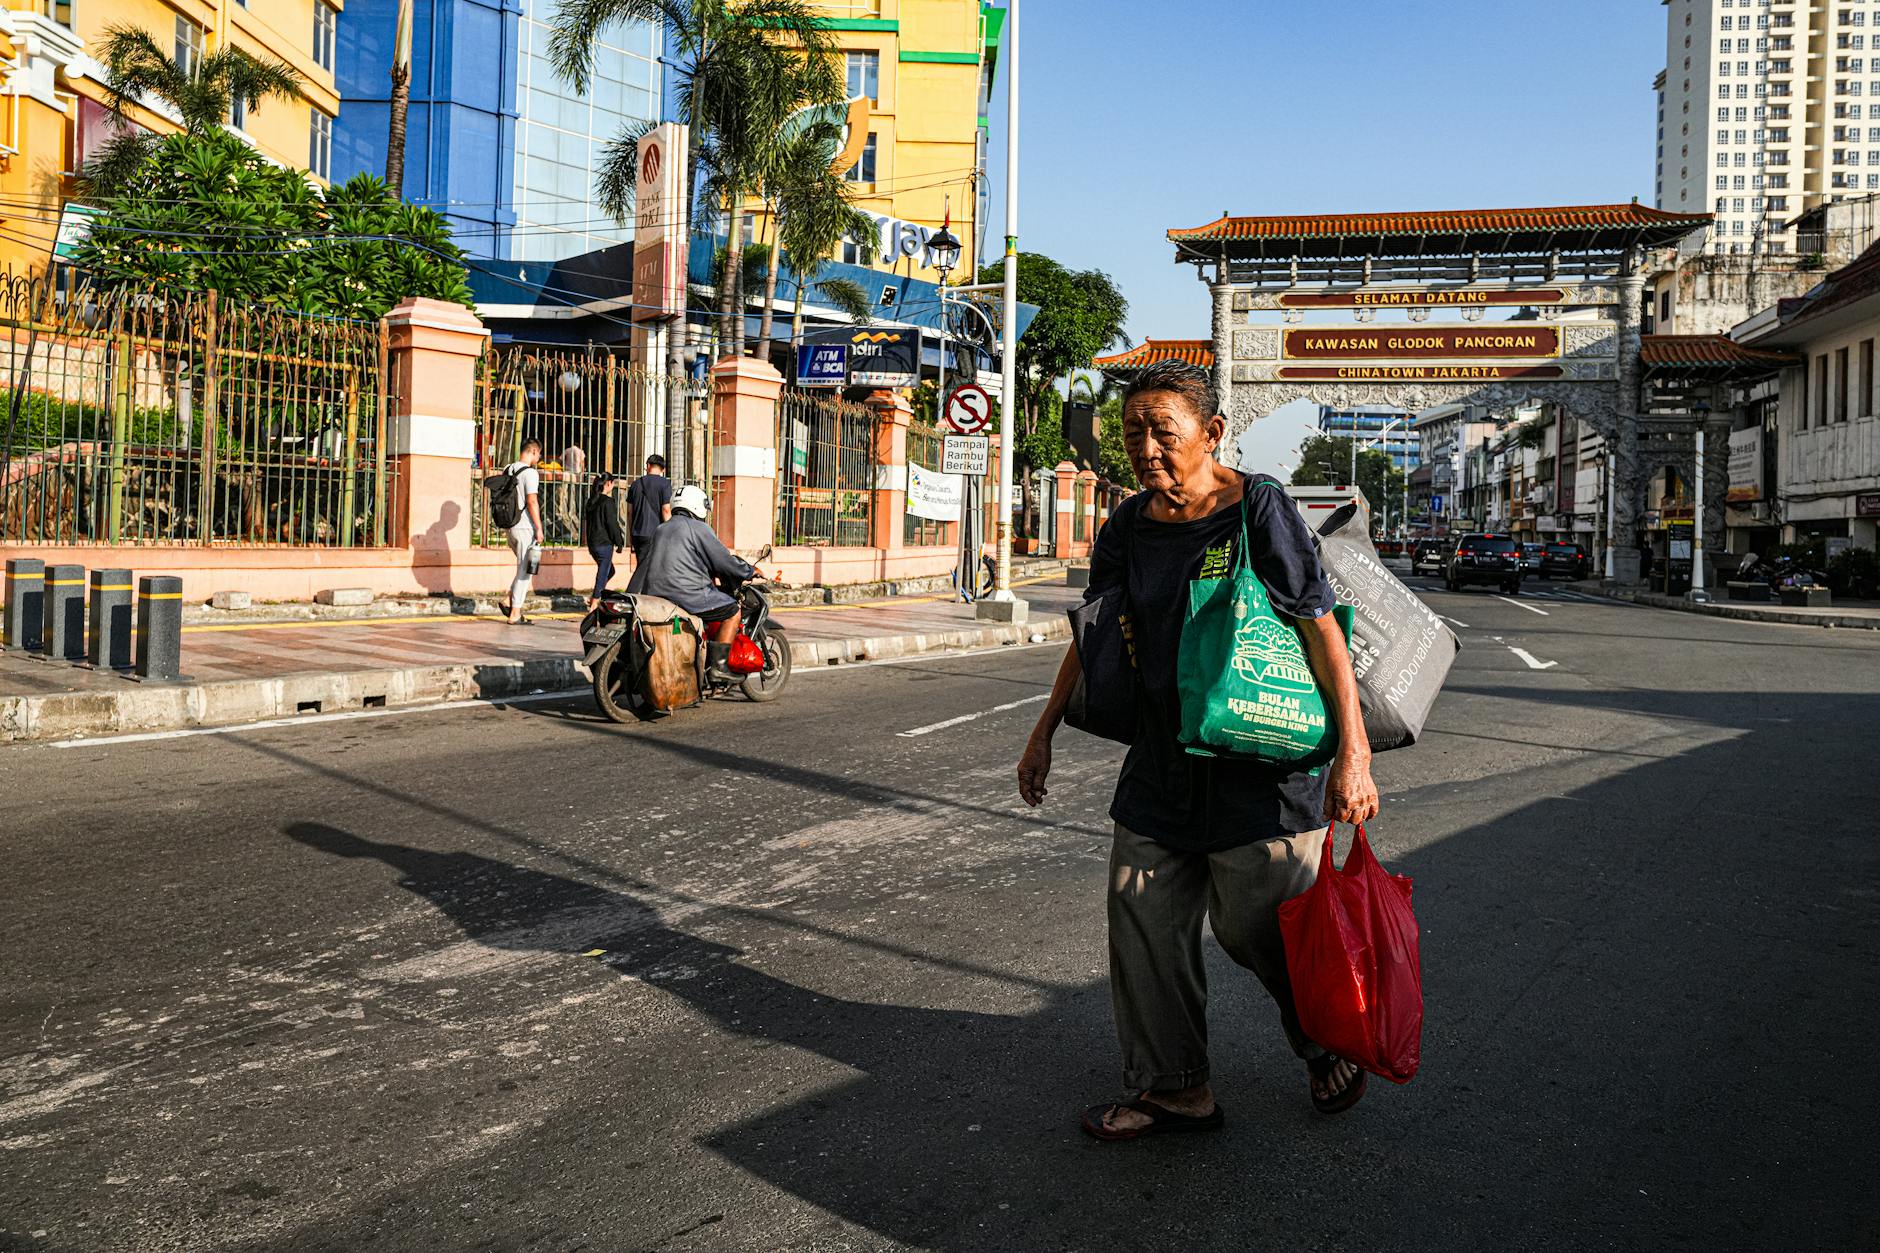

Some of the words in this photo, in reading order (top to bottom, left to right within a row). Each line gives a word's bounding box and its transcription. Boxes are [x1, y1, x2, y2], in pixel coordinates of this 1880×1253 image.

[641, 192, 660, 210] BANK
[641, 207, 660, 229] DKI
[1354, 293, 1419, 304] SELAMAT
[1427, 292, 1487, 303] DATANG
[1305, 338, 1378, 350] KAWASAN
[1387, 337, 1444, 349] GLODOK
[1455, 336, 1536, 348] PANCORAN
[815, 350, 839, 361] ATM
[822, 362, 843, 373] BCA
[1338, 367, 1425, 378] CHINATOWN
[1431, 366, 1499, 377] JAKARTA
[947, 439, 985, 452] Sampai
[947, 451, 984, 461] Rambu
[946, 461, 983, 471] Berikut
[1385, 626, 1437, 708] McDonald's
[1258, 691, 1300, 710] BULAN
[1227, 697, 1325, 728] KEBERSAMAAN
[1243, 713, 1252, 722] DI
[1253, 715, 1288, 729] BURGER
[1288, 721, 1309, 733] KING
